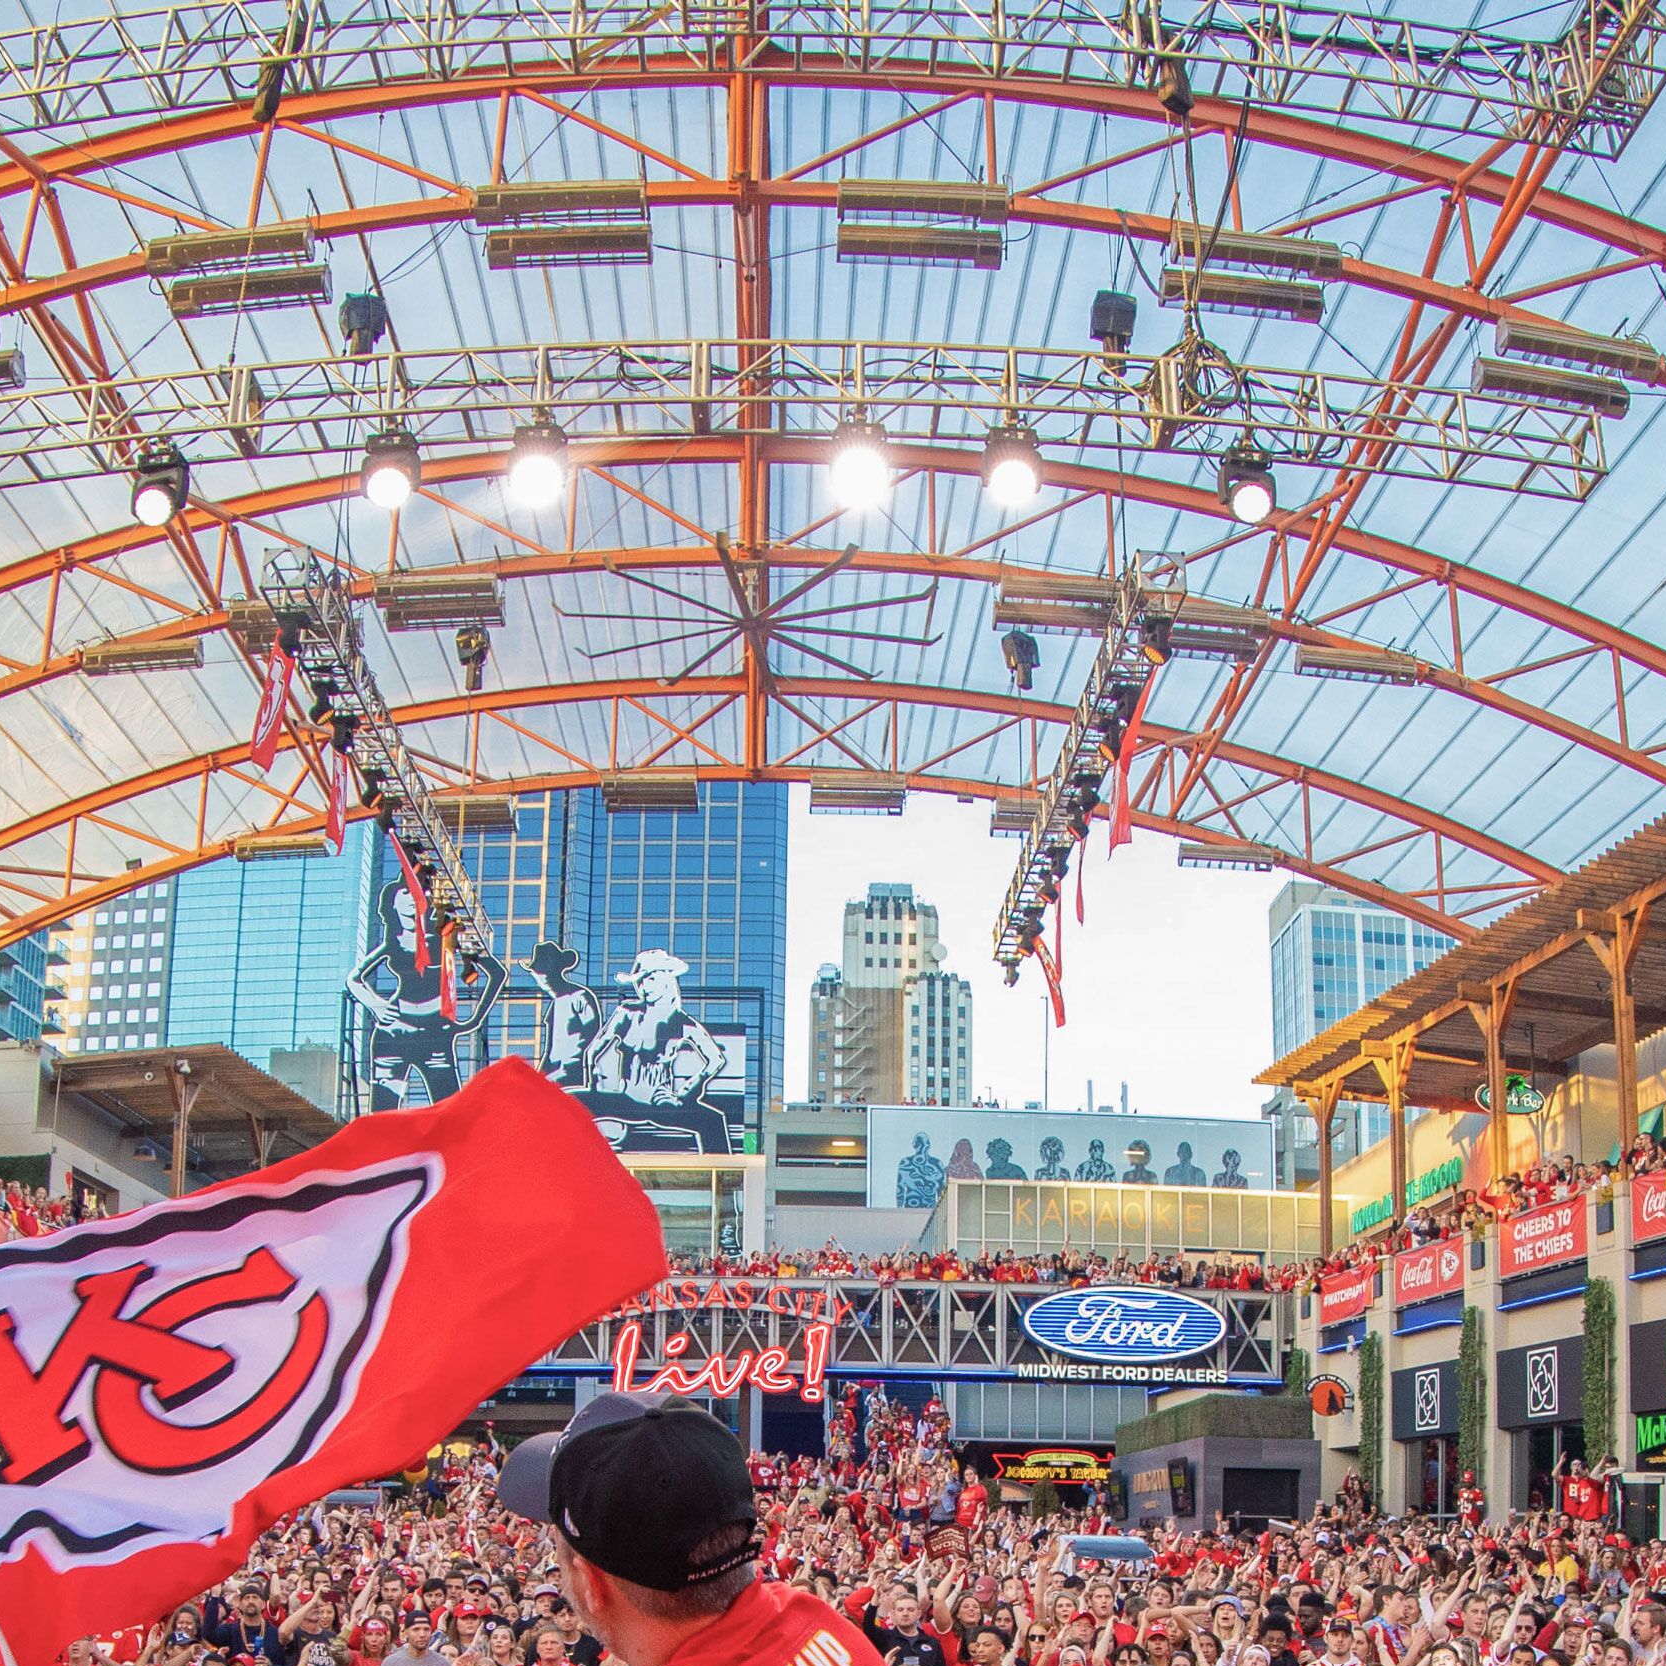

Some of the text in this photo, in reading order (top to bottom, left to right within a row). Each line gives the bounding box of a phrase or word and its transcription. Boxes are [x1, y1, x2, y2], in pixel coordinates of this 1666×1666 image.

[1014, 1197, 1205, 1233] KARAOKE
[1514, 1208, 1572, 1241] CHEERS TO
[1513, 1236, 1574, 1265] THE CHIEFS
[767, 1285, 854, 1325] CITY
[1064, 1295, 1189, 1348] Ford
[1017, 1363, 1229, 1383] MIDWEST FORD DEALERS
[687, 1567, 718, 1581] MIAMI
